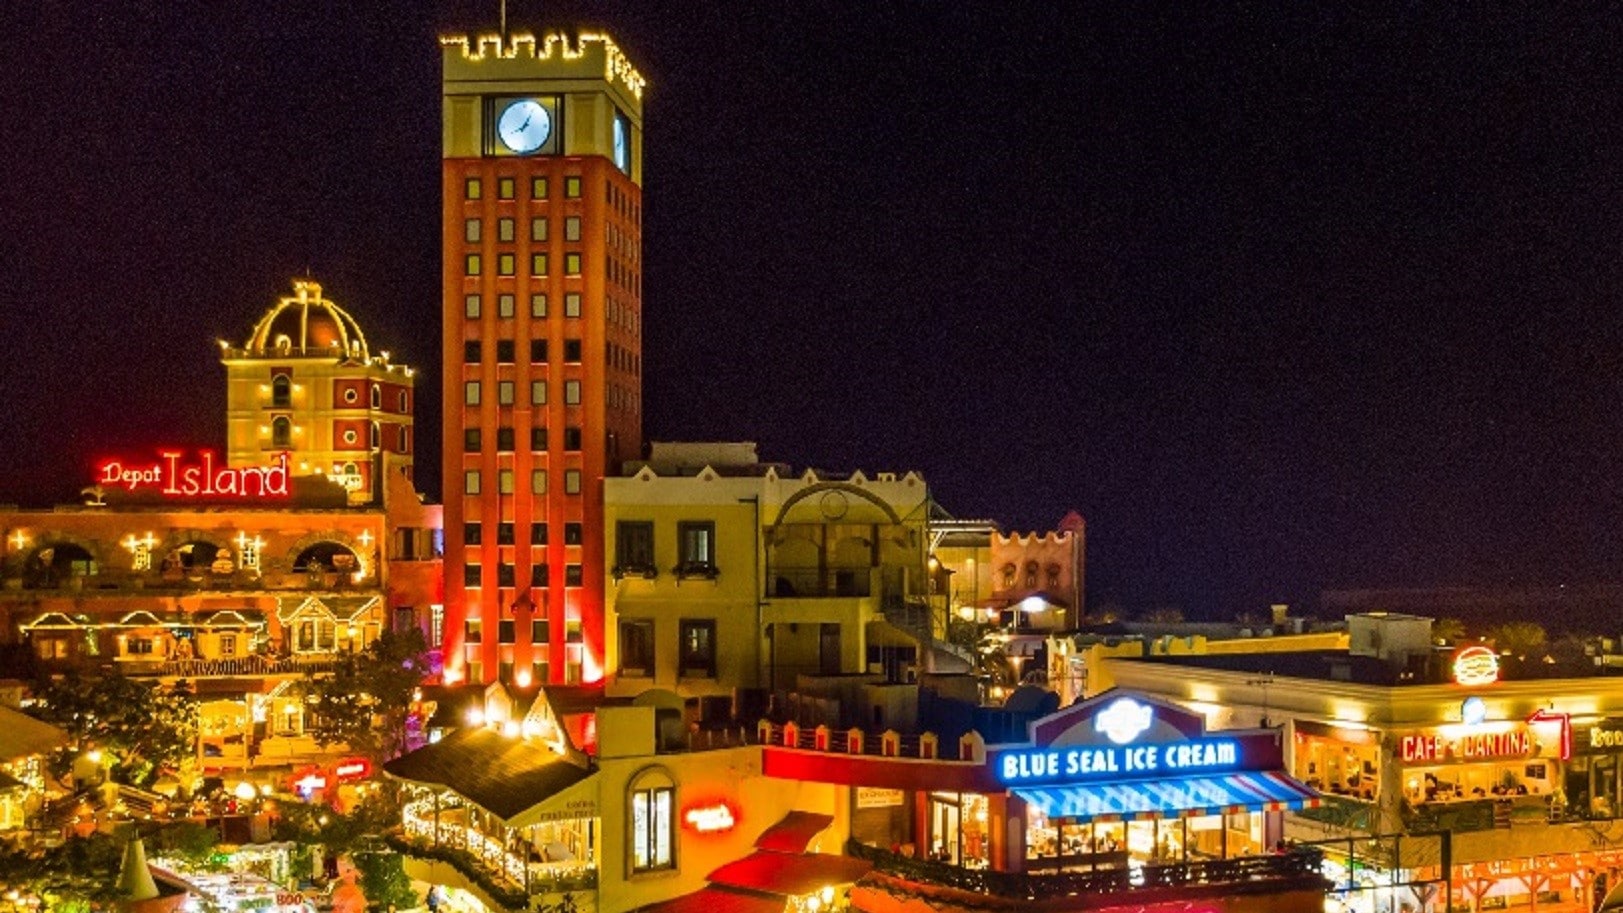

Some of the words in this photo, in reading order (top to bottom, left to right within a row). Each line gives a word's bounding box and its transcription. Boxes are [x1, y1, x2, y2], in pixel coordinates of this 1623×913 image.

[102, 463, 162, 490] Depot
[163, 453, 288, 495] Island
[1003, 752, 1059, 779] BLUE
[1066, 750, 1119, 774] SEAL
[1125, 746, 1158, 771] ICE
[1165, 743, 1236, 768] CREAM
[1403, 735, 1443, 761] CAFE
